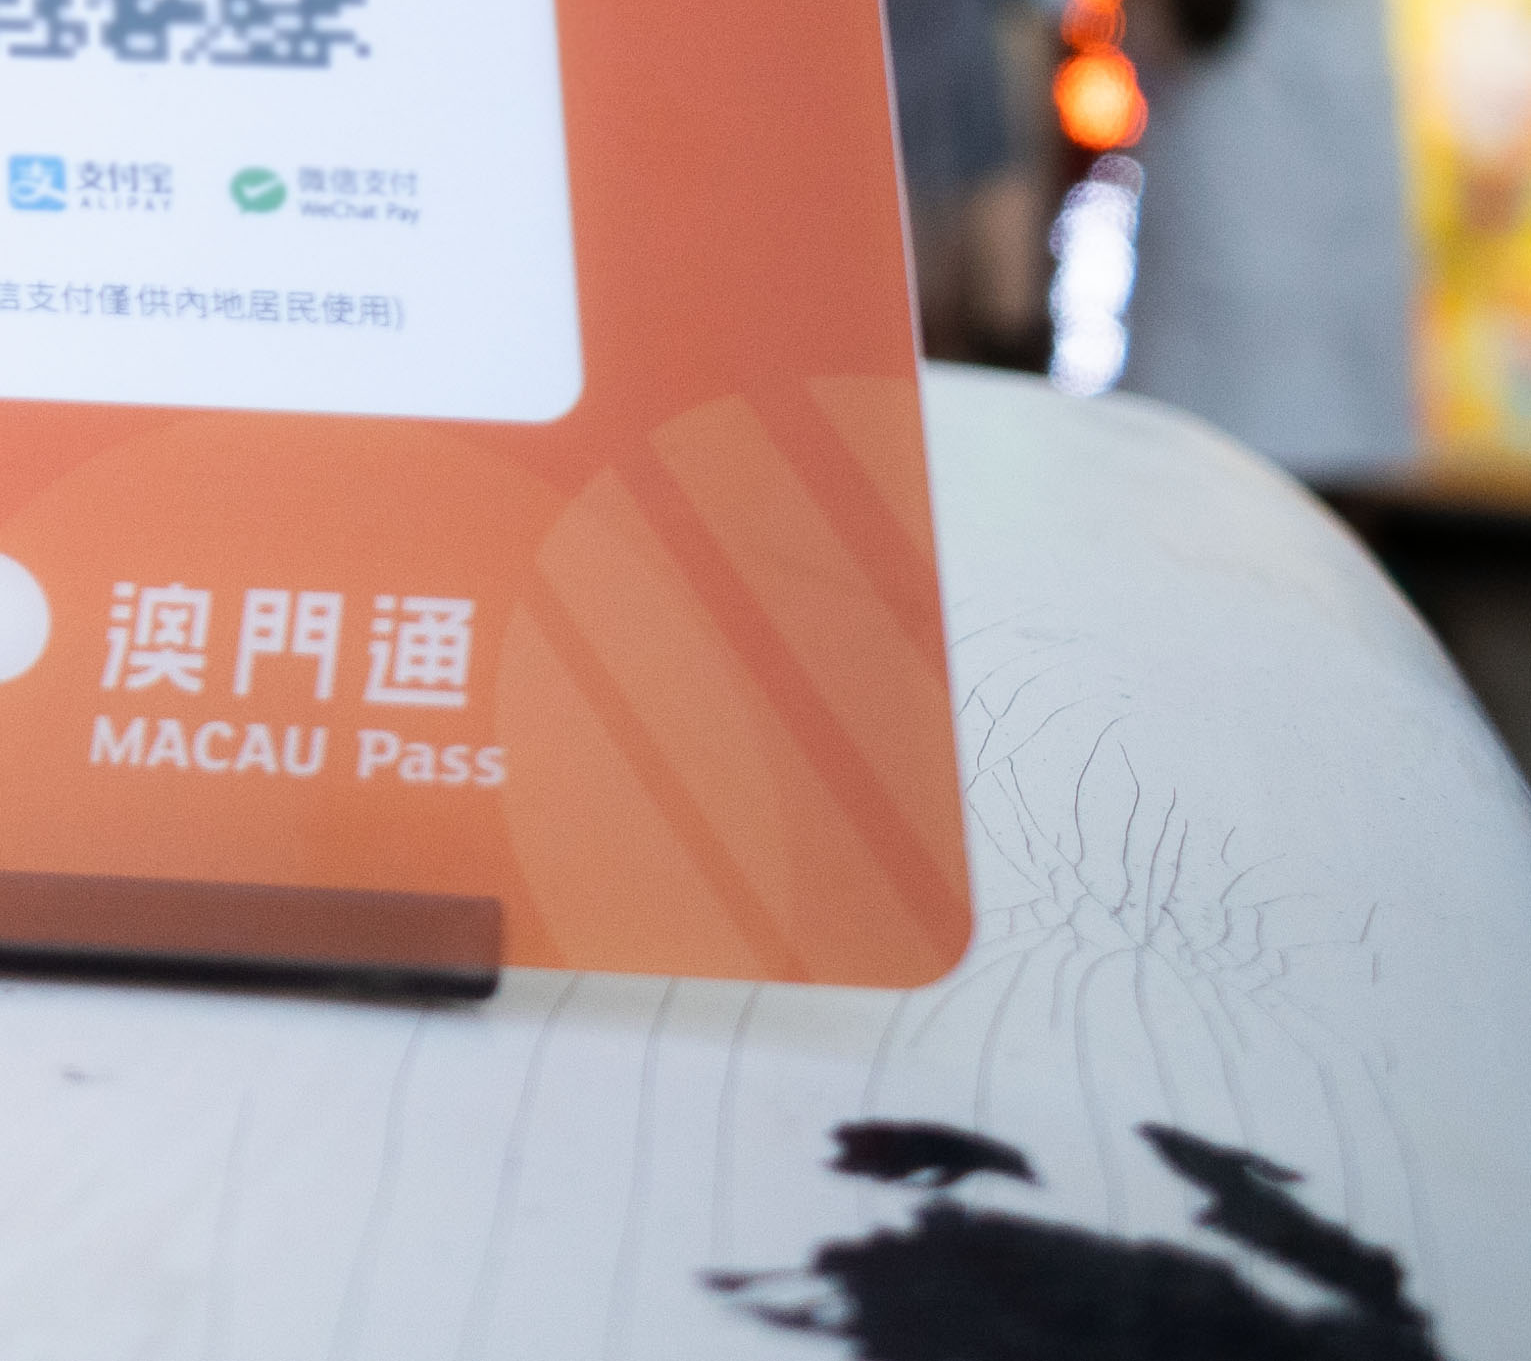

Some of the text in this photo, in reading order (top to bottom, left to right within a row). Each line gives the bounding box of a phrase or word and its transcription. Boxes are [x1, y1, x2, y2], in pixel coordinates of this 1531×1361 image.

[298, 166, 418, 197] 微信支付
[79, 195, 172, 211] ALIPAY
[298, 200, 421, 224] WeChat Pay
[101, 581, 476, 710] 澳門通
[89, 714, 509, 787] MACAU Pass
